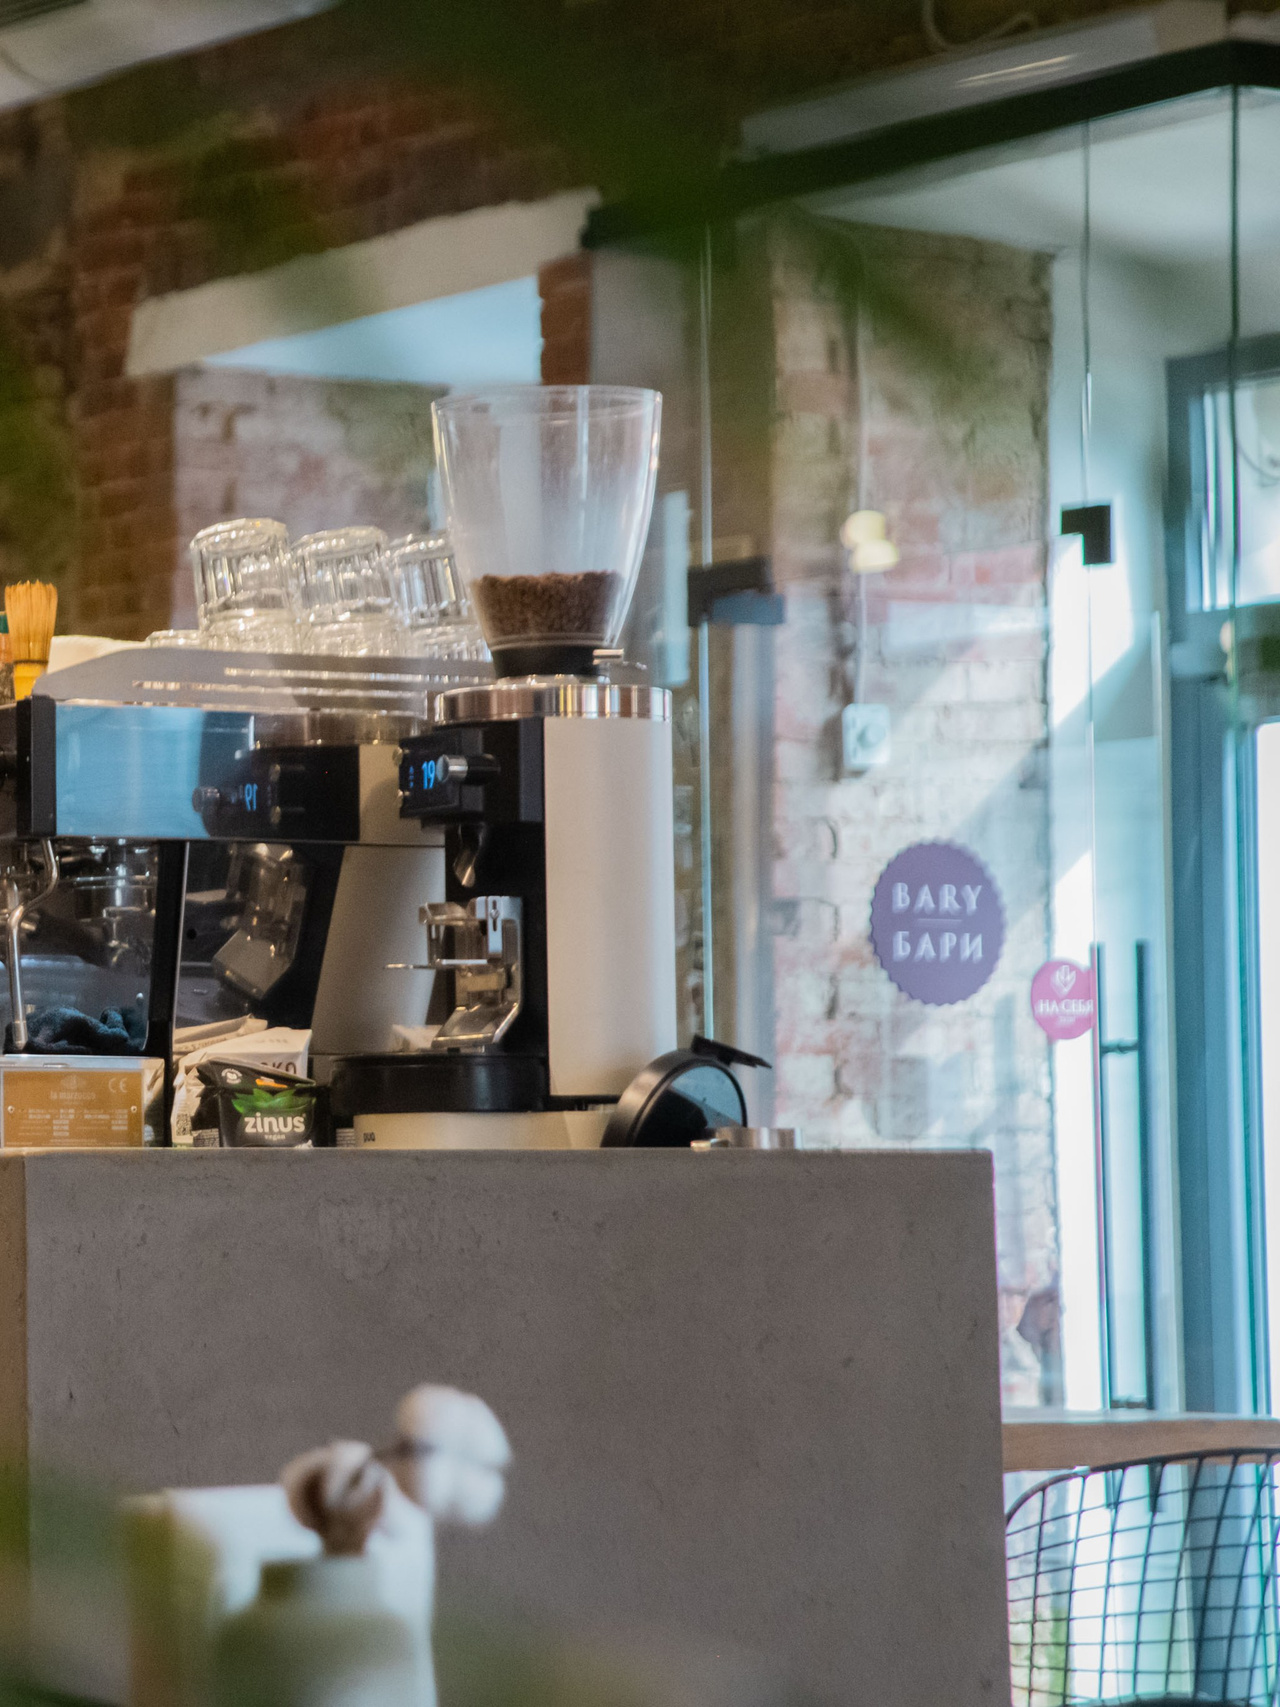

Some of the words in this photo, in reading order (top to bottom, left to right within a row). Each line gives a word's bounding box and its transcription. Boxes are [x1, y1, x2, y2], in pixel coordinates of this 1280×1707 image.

[422, 760, 436, 790] 19
[893, 883, 982, 912] BARY
[893, 931, 983, 961] БАРИ
[244, 1112, 306, 1133] zinus
